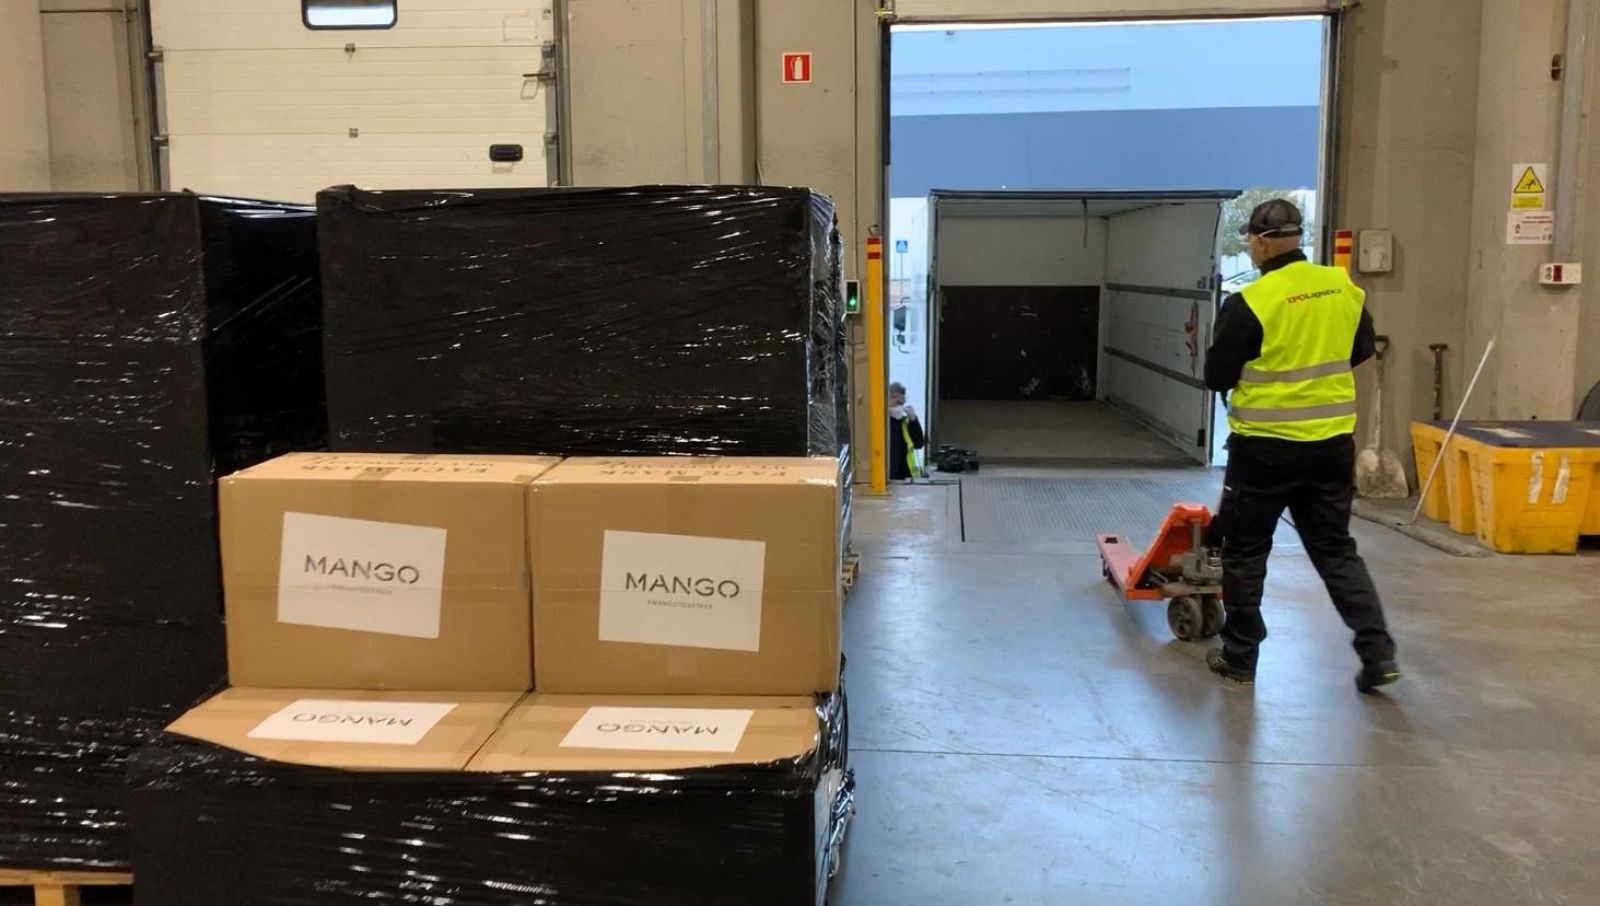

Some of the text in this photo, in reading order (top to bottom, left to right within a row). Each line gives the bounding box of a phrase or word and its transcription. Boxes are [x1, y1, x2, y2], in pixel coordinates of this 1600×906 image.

[304, 554, 420, 585] MANGO
[625, 572, 740, 600] MANGO
[292, 713, 413, 727] MANGO
[596, 722, 719, 735] MANGO
